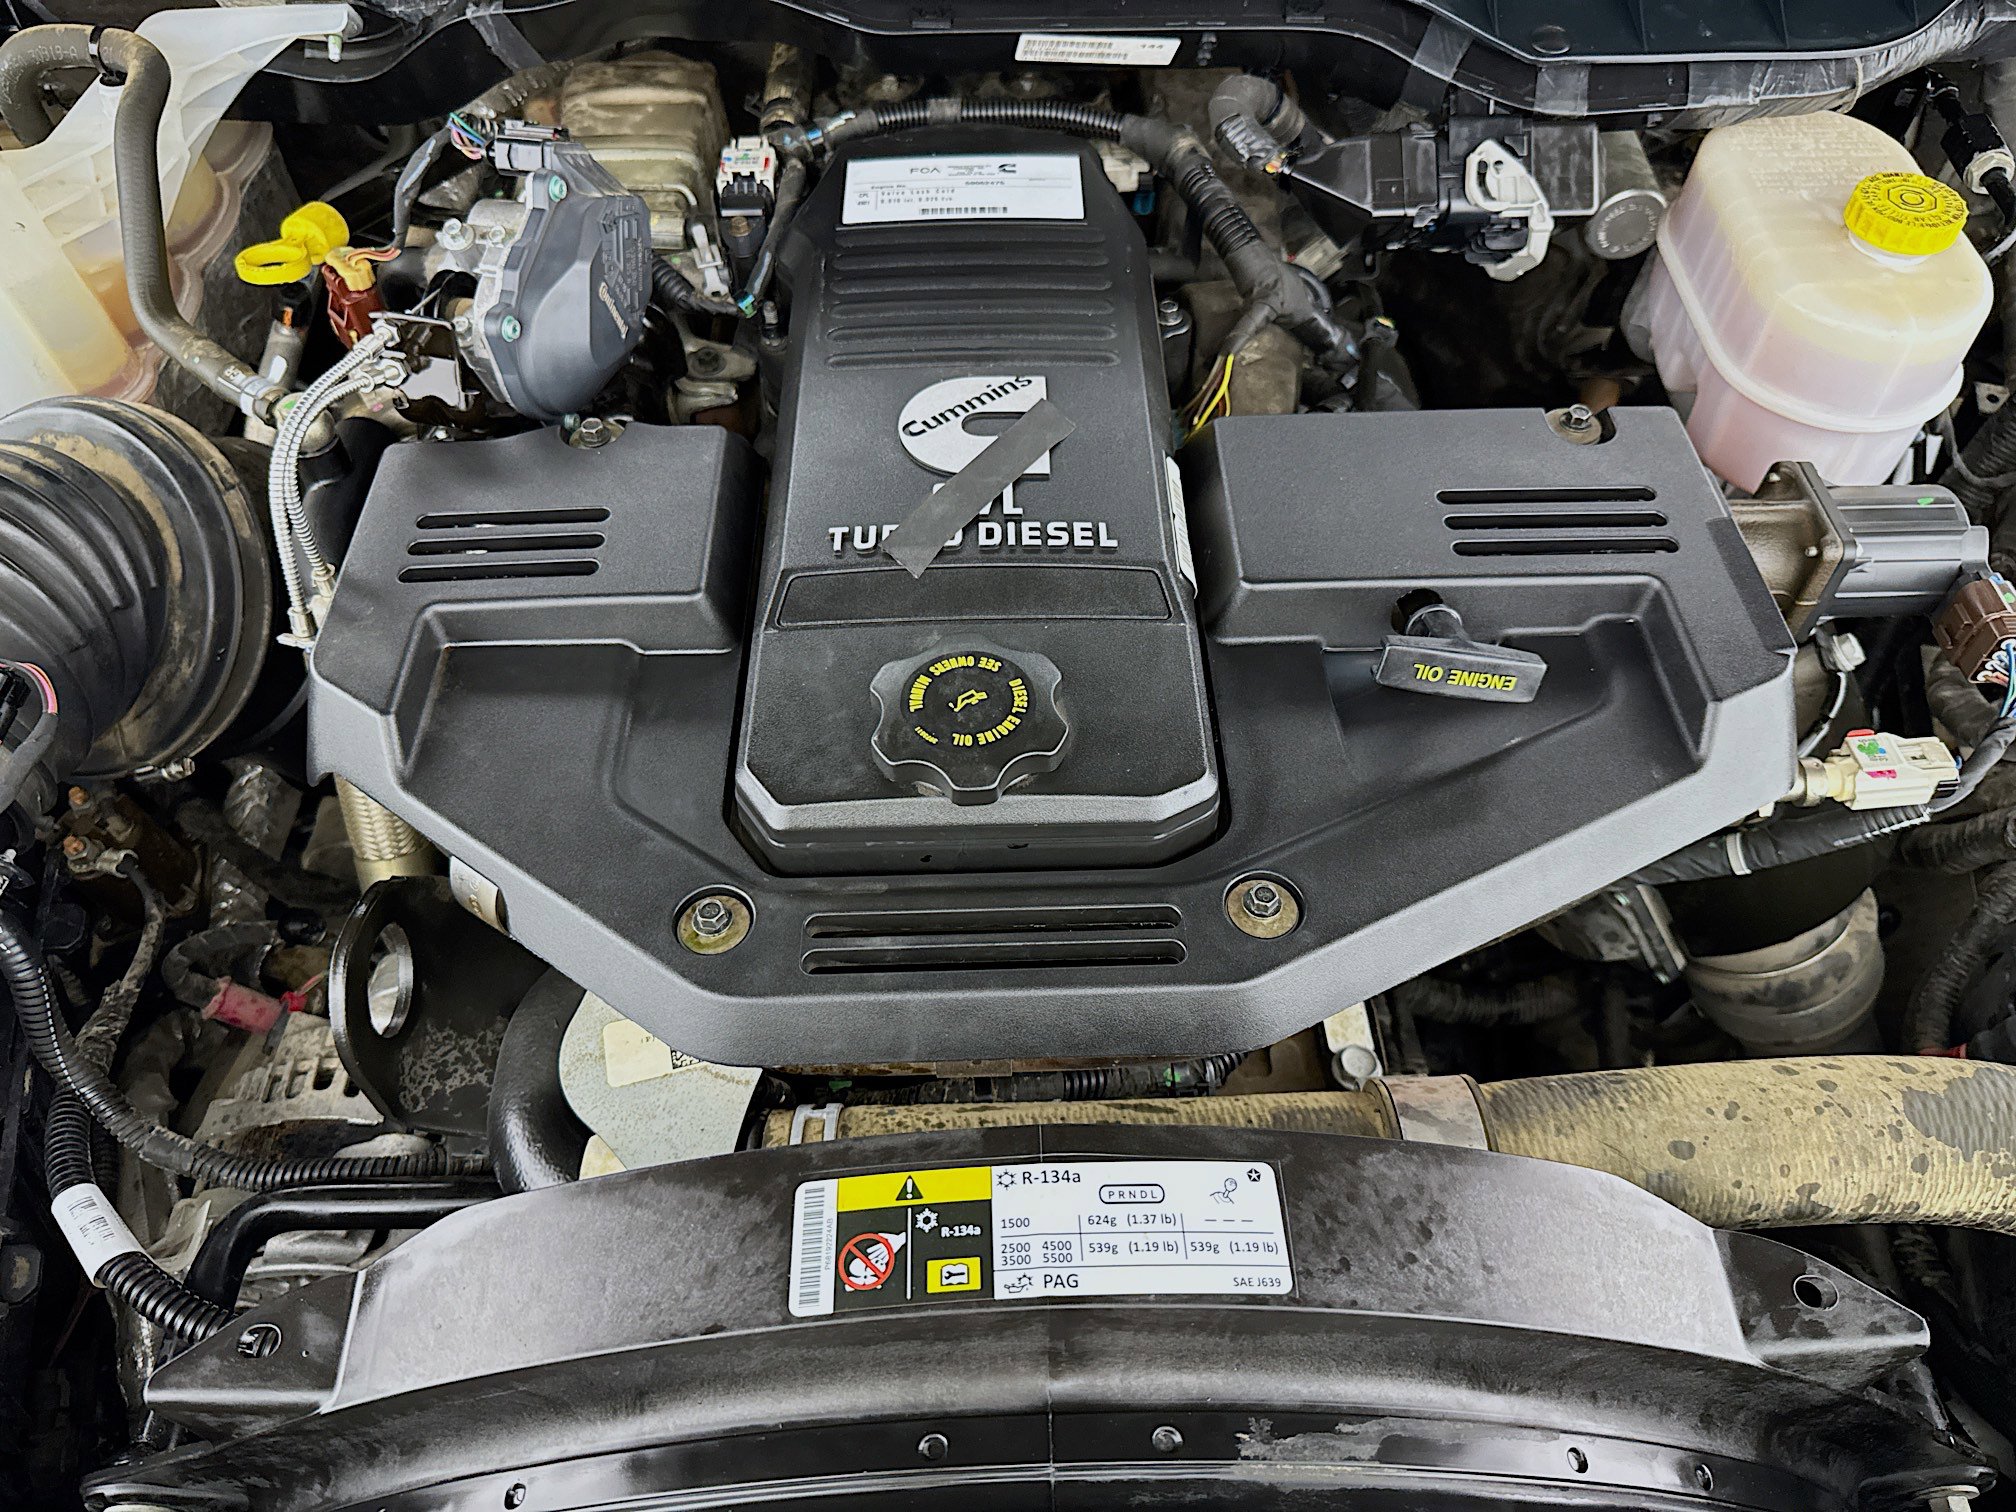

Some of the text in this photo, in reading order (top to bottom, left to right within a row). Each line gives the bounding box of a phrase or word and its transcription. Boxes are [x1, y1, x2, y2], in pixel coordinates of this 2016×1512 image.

[902, 376, 1033, 437] Cummins
[977, 520, 1119, 548] DIESEL
[908, 655, 1003, 713] SEE OWNERS MANUAL
[1413, 663, 1518, 692] ENGINE OIL
[1008, 677, 1029, 714] DIESEL
[976, 714, 1022, 746] ENGINE
[952, 733, 973, 746] OIL
[1021, 1169, 1082, 1185] R-134a
[1001, 1213, 1177, 1229] 1500 624g (1.37 lb)
[940, 1224, 982, 1238] R-134a
[1001, 1240, 1279, 1256] 2500 4500 539g (1.19 lb) 539g (1.19 lb)
[1001, 1252, 1073, 1266] 3500 5500
[1043, 1273, 1079, 1289] PAG
[1233, 1276, 1282, 1288] SAE J639
